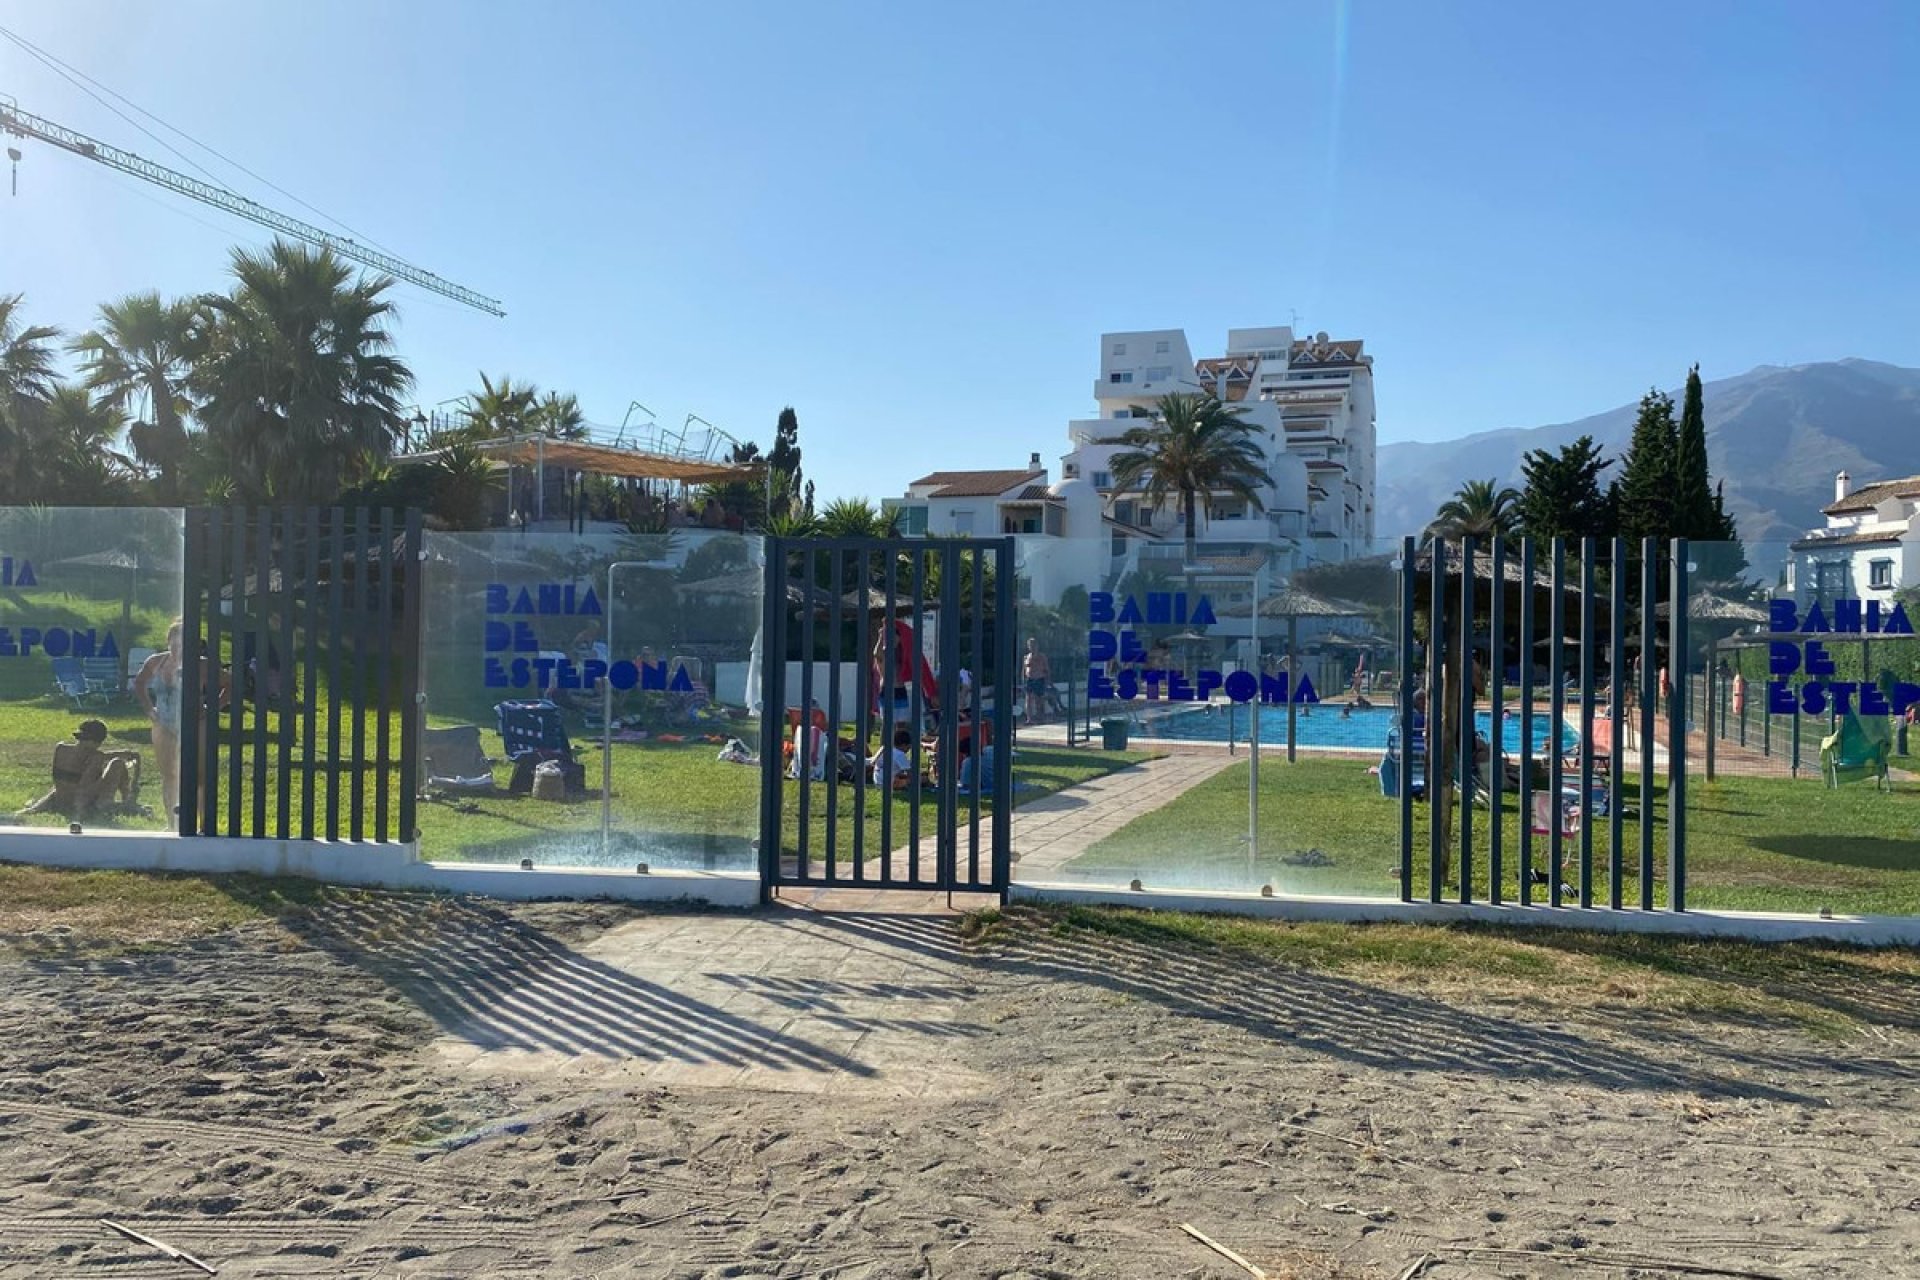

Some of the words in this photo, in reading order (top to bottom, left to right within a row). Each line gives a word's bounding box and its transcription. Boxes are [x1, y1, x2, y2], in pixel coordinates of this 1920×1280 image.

[487, 584, 602, 615] BAHIA
[1090, 592, 1217, 624] BAHIA
[1770, 600, 1914, 633] BAHIA
[485, 621, 538, 652] DE
[1089, 630, 1146, 662] DE
[1770, 641, 1834, 674] DE
[485, 658, 694, 690] ESTEPONA
[1089, 669, 1320, 702] ESTEPONA
[1770, 681, 1920, 715] ESTEP
